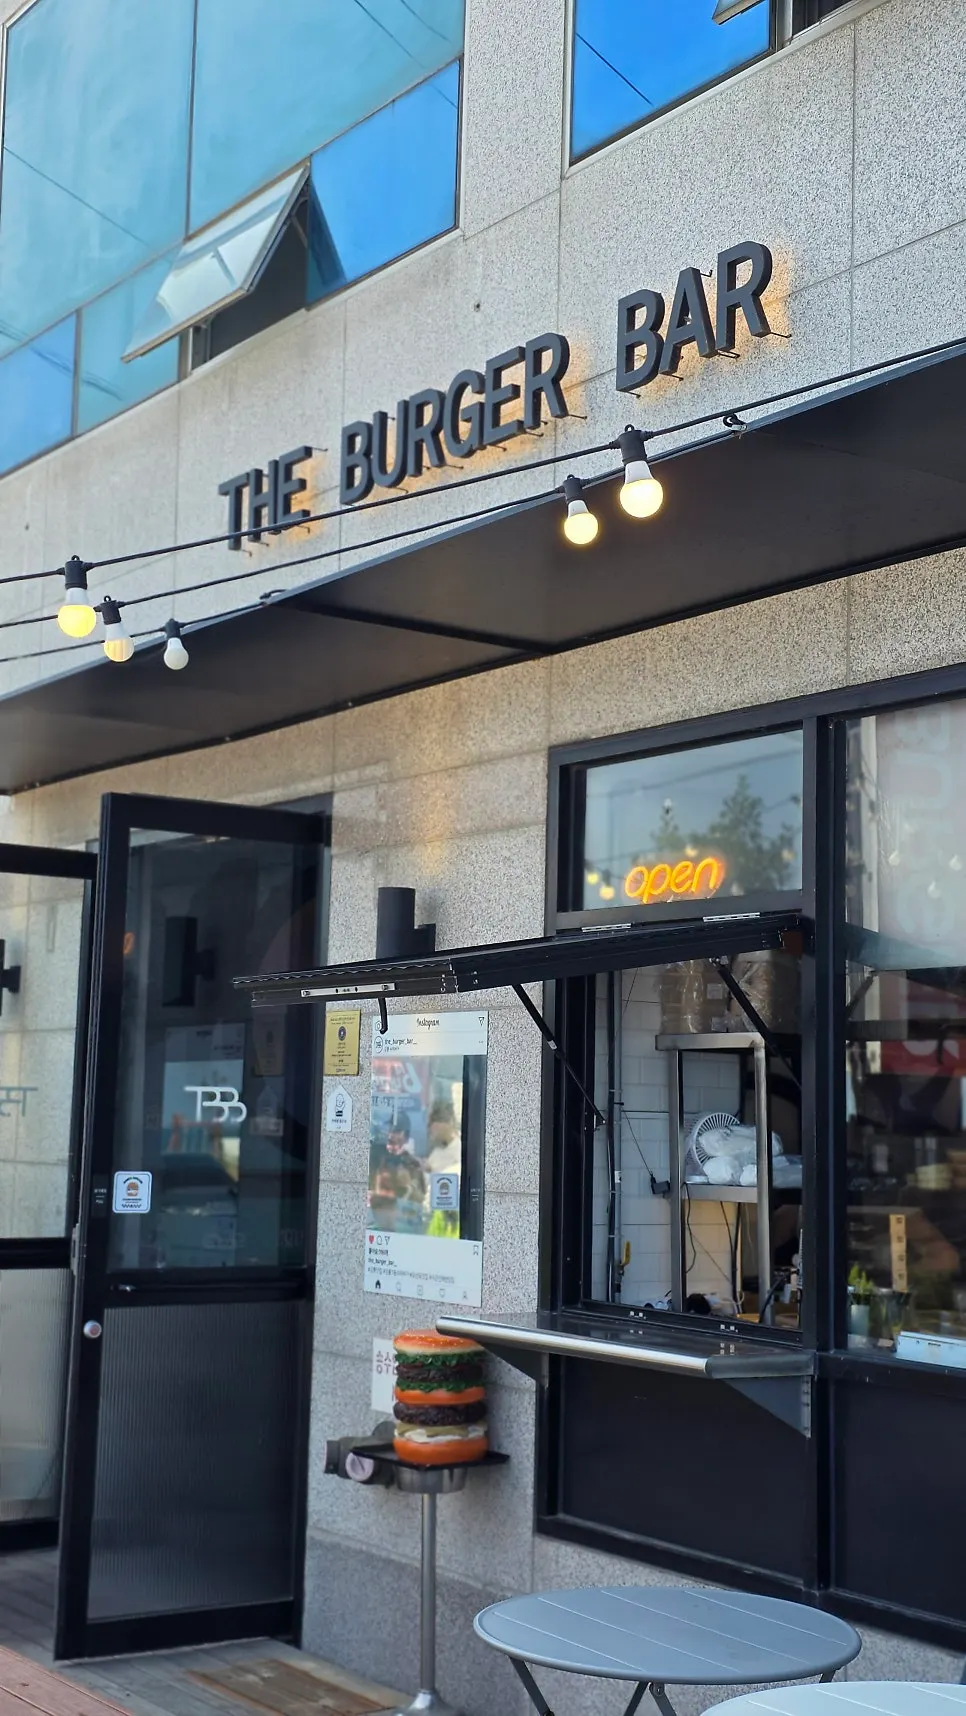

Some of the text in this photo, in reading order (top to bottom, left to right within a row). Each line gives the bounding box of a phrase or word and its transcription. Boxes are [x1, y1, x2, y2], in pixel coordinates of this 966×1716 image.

[218, 241, 773, 550] THE BURGER BAR
[624, 857, 719, 904] open
[416, 1017, 440, 1030] Instagram
